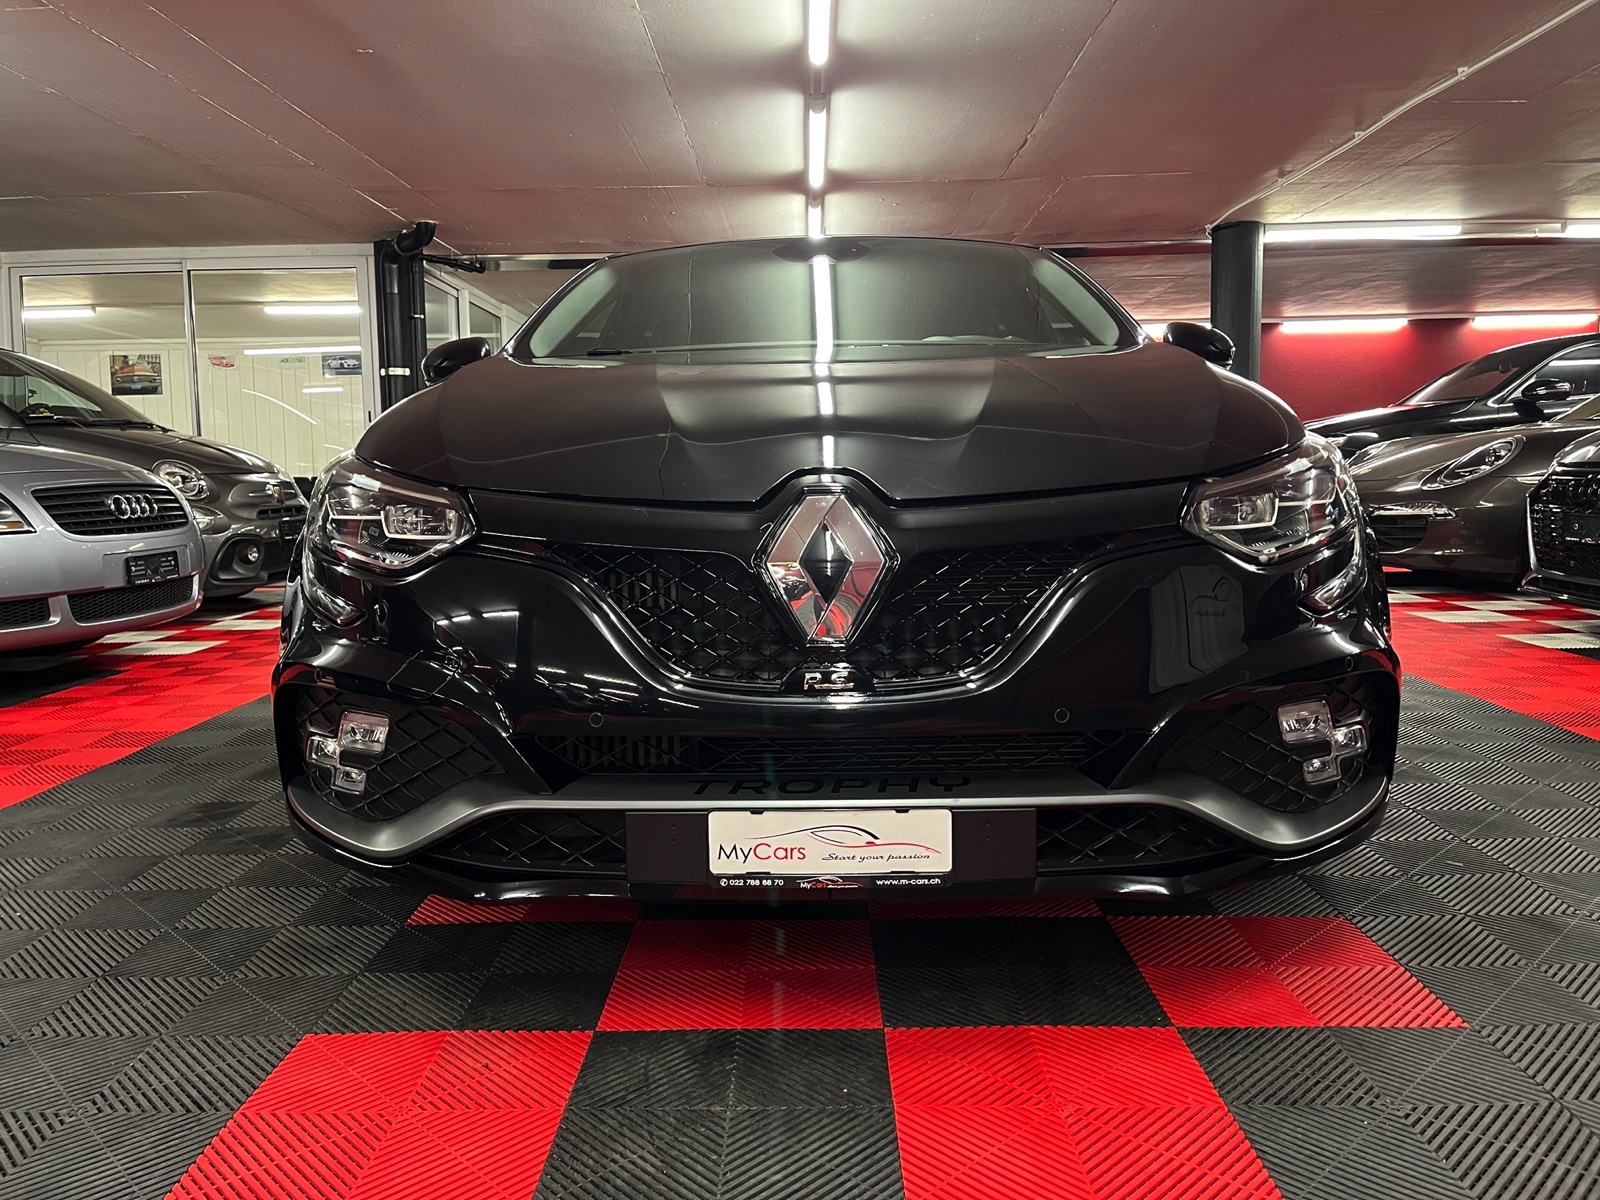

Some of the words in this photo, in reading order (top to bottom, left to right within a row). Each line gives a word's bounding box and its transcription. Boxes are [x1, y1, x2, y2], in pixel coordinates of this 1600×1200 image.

[688, 777, 971, 795] TROPHY
[717, 842, 806, 864] MyCars
[821, 852, 857, 861] Start
[858, 855, 885, 863] your
[886, 852, 931, 862] passion
[876, 877, 941, 885] www.m-cars.ch
